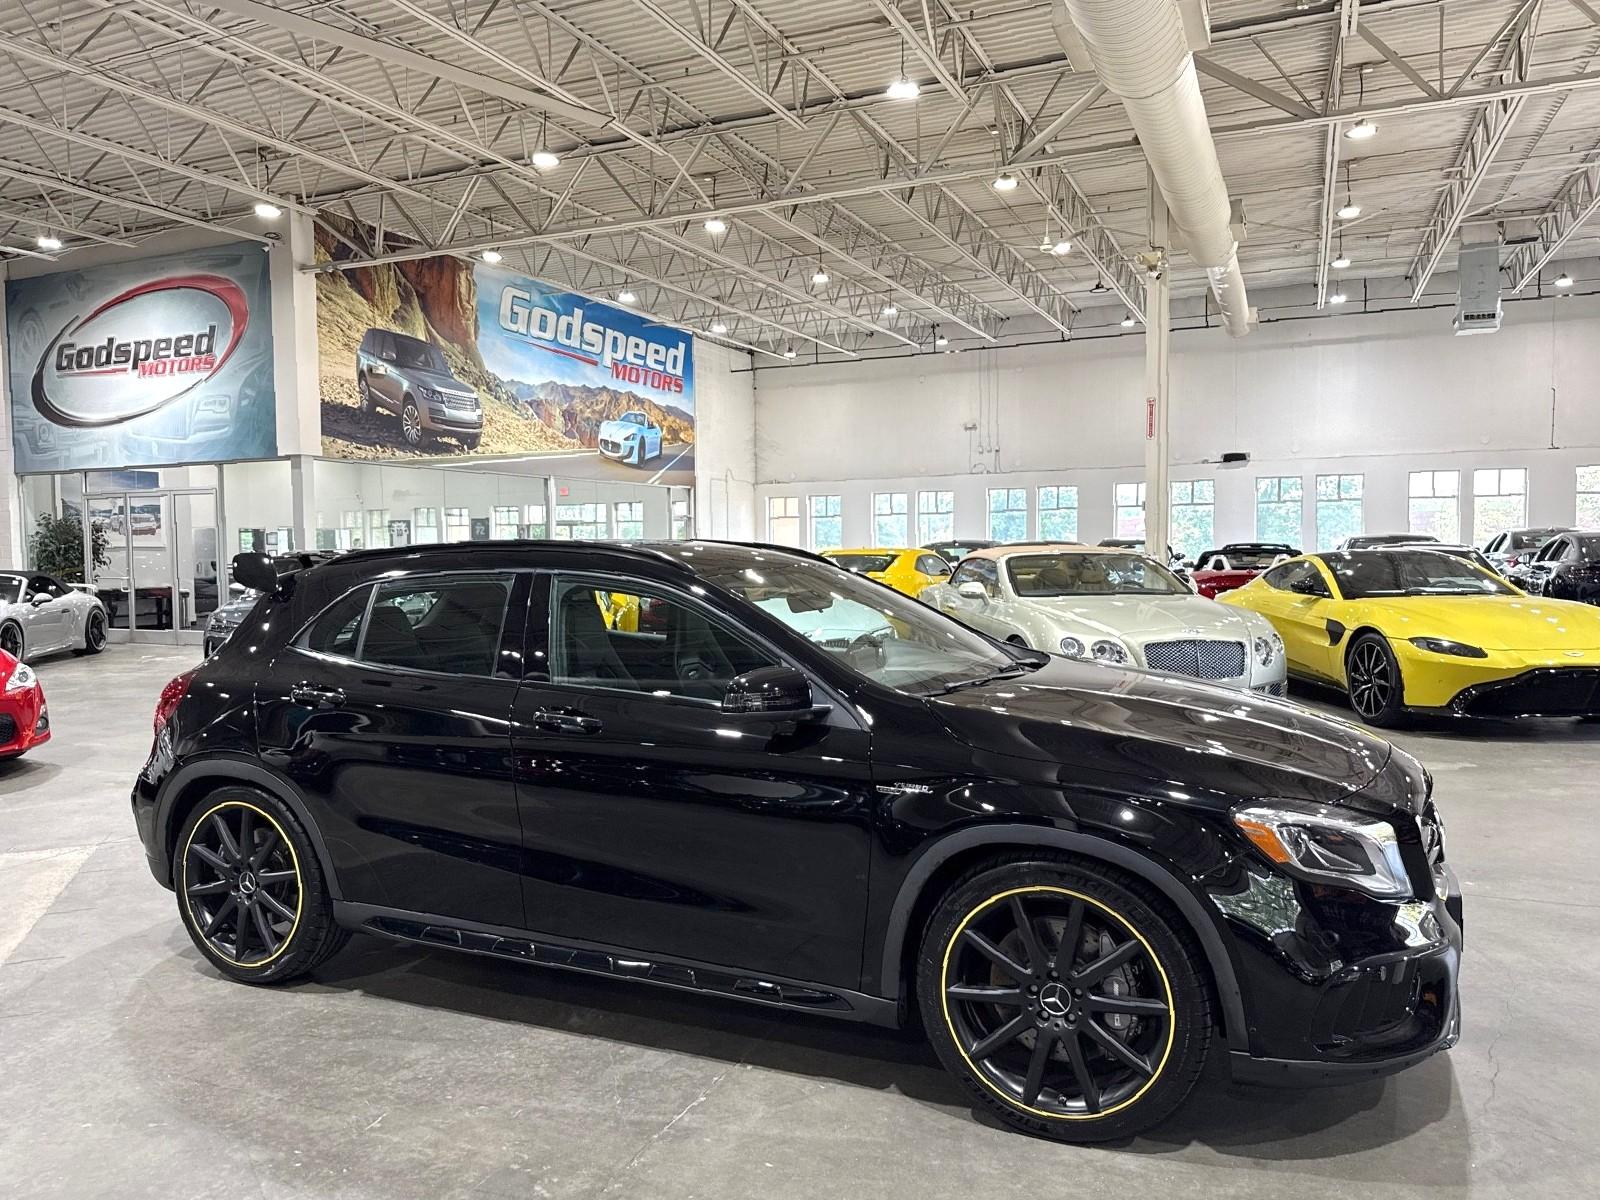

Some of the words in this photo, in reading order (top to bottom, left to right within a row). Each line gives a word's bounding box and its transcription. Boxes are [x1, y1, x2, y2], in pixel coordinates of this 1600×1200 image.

[55, 324, 217, 371] Godspeed
[499, 285, 686, 377] Godspeed
[137, 355, 217, 378] MOTORS
[611, 361, 685, 394] MOTORS
